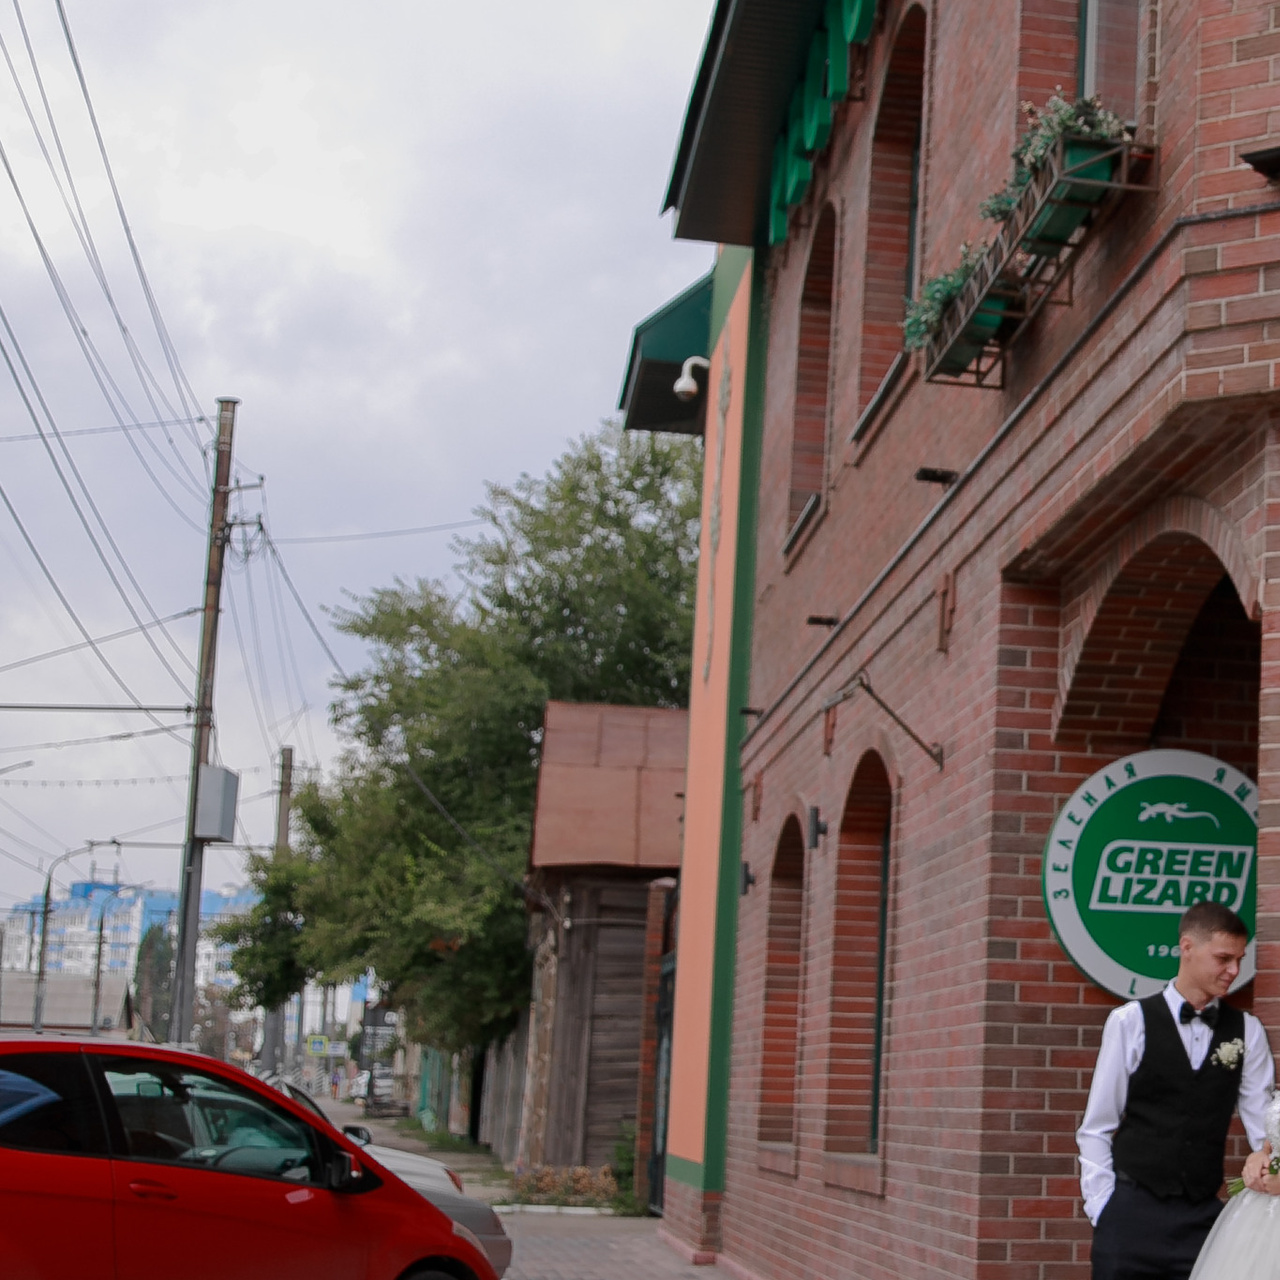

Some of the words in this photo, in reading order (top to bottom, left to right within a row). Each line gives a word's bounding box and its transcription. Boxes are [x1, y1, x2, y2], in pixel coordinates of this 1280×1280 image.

[1106, 846, 1246, 878] GREEN
[1097, 877, 1238, 907] LIZARD
[1146, 943, 1181, 958] 196
